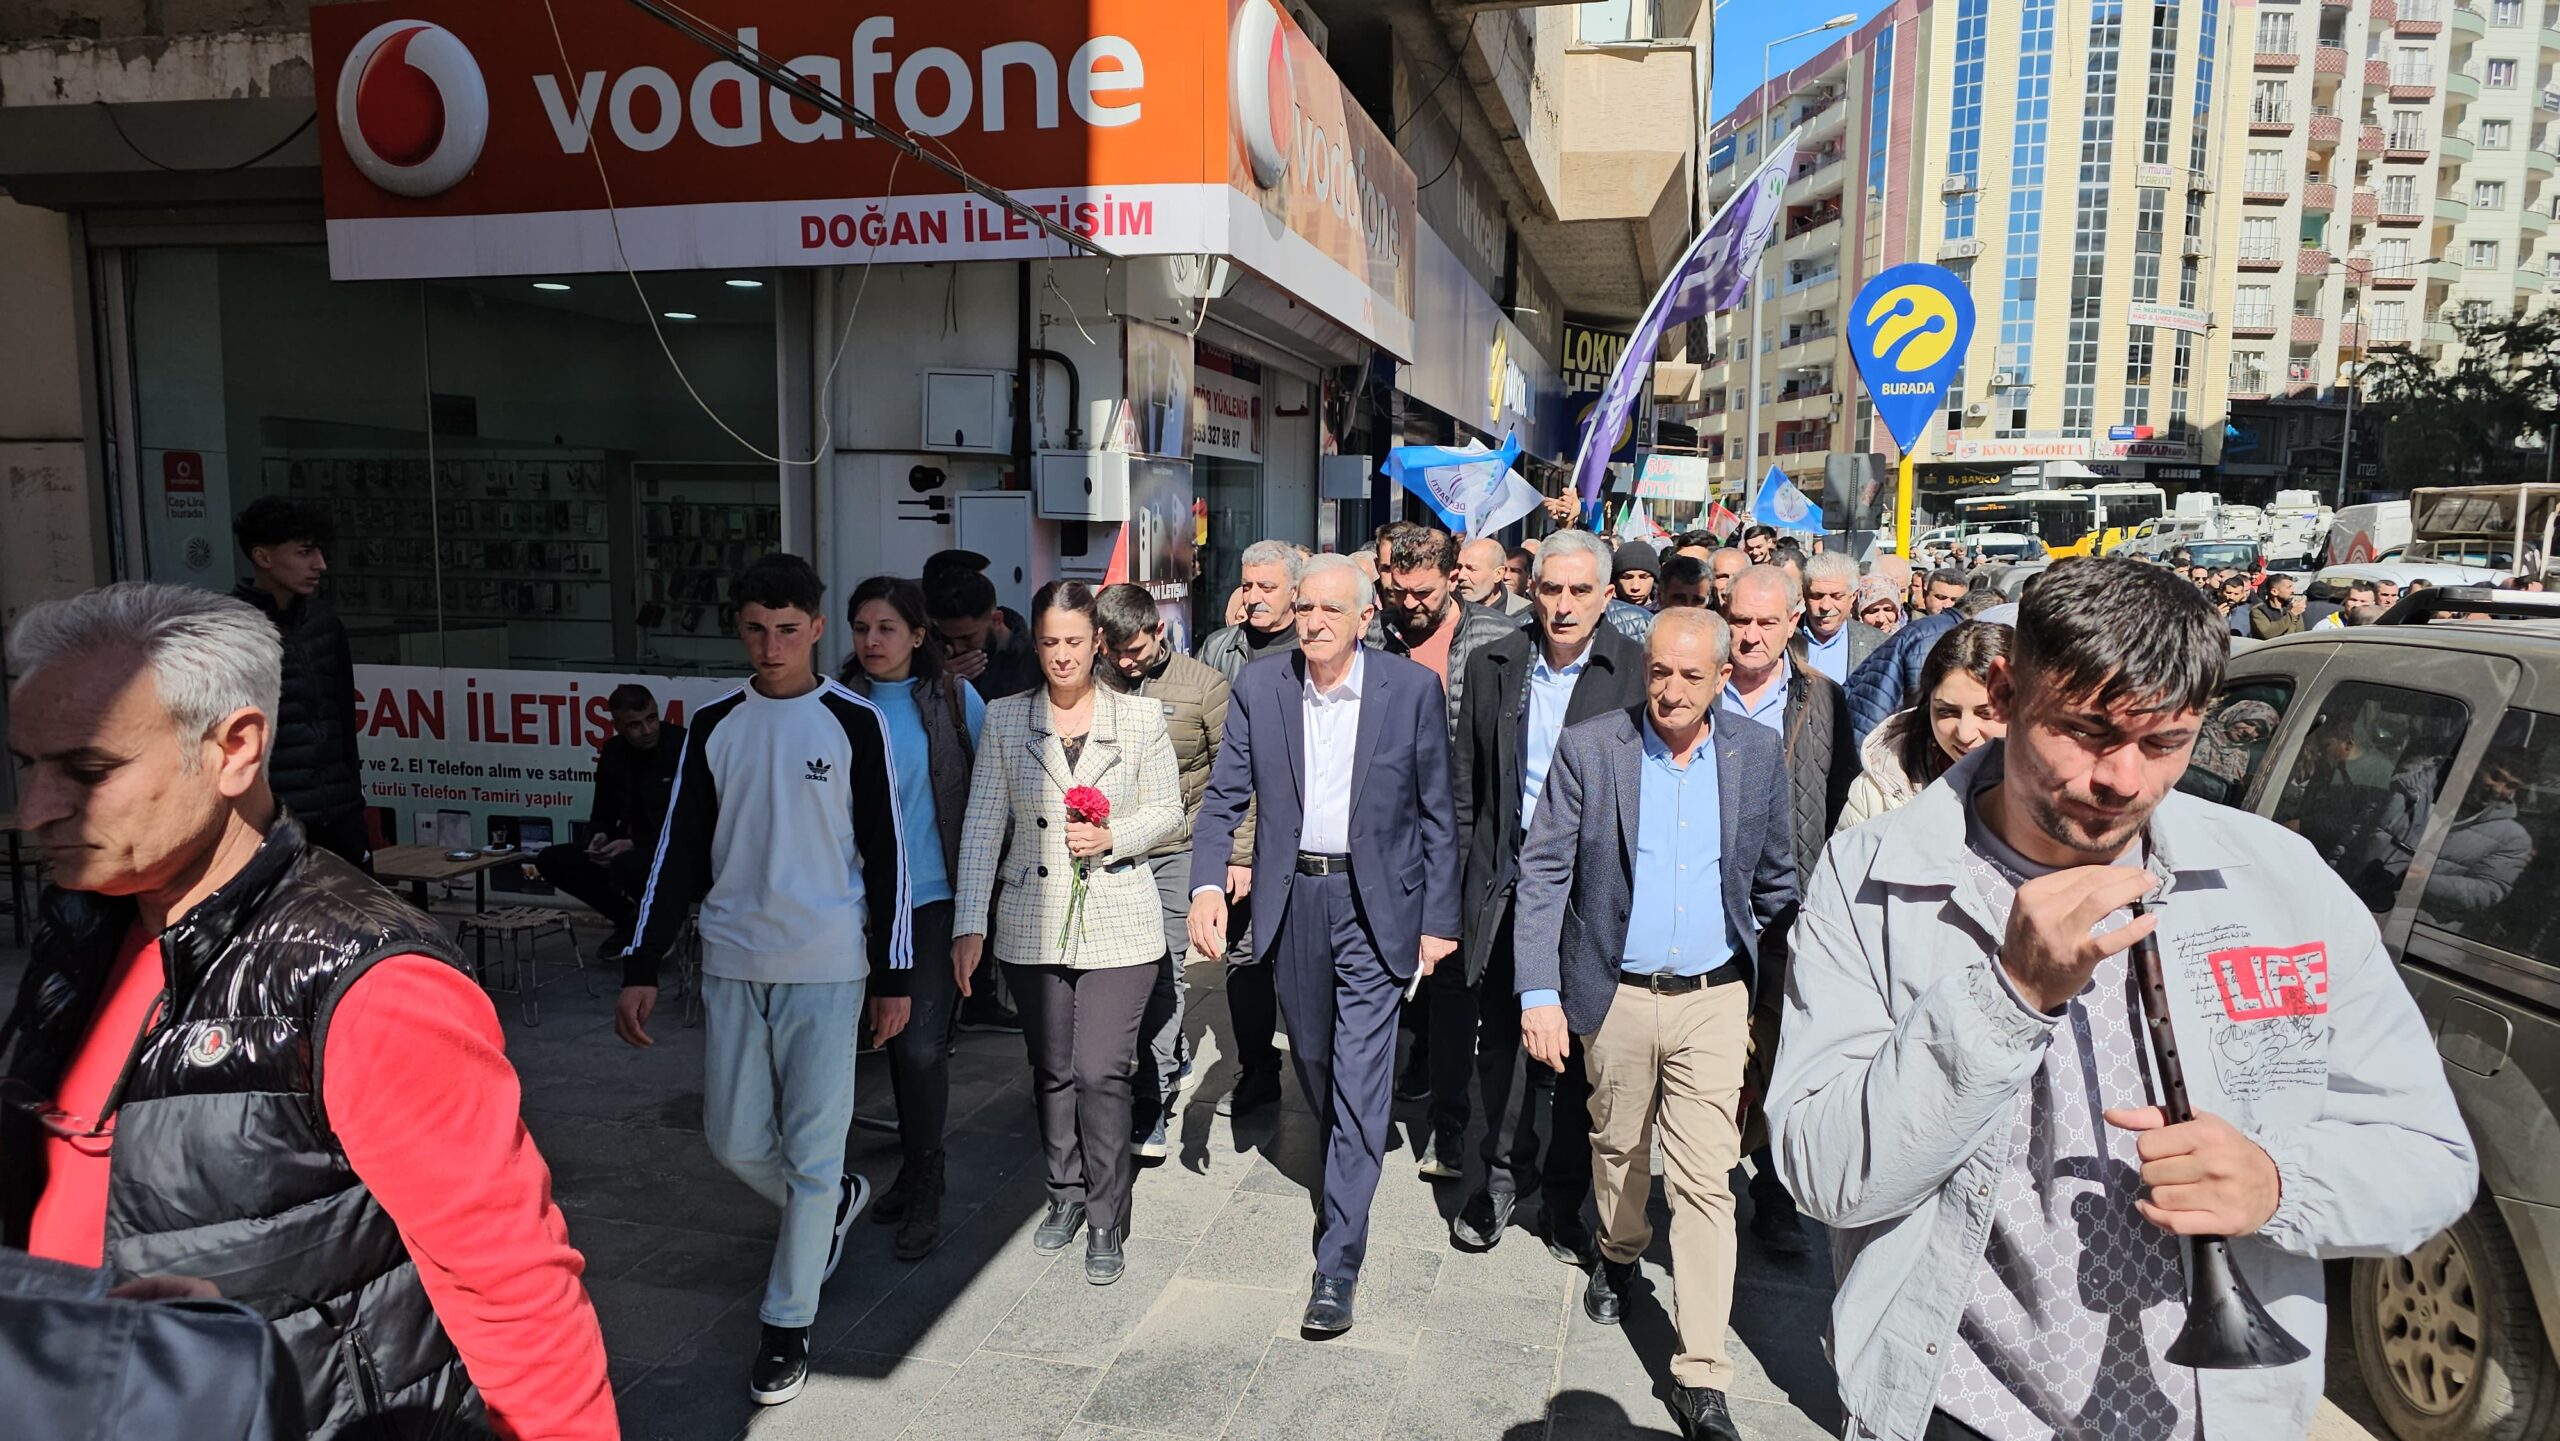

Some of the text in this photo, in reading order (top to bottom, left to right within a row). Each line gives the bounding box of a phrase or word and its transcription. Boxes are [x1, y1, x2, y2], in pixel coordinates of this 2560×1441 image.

[533, 16, 1145, 154] vodafone
[1294, 101, 1400, 267] vodafone
[801, 193, 1153, 249] DOĞAN İLETİŞİM
[1563, 328, 1636, 376] LOKM
[1881, 382, 1935, 396] BURADA
[1213, 389, 1248, 421] YÜKLENİR
[1208, 425, 1220, 445] 327
[1222, 428, 1230, 447] 98
[1232, 430, 1240, 448] 87
[2089, 464, 2121, 476] REGAL
[2158, 468, 2201, 479] SAMSUNG
[168, 496, 205, 508] Cep Lira
[171, 509, 203, 519] burada
[369, 758, 386, 772] ve
[391, 757, 404, 773] 2.
[409, 758, 423, 774] El
[428, 759, 483, 777] Telefon
[489, 762, 521, 779] alım
[526, 767, 544, 780] ve
[804, 774, 828, 782] adidas
[372, 782, 406, 798] türlü
[411, 783, 466, 800] Telefon
[472, 786, 519, 804] Tamiri
[525, 791, 573, 808] yapılır
[2219, 951, 2328, 1012] LIFE
